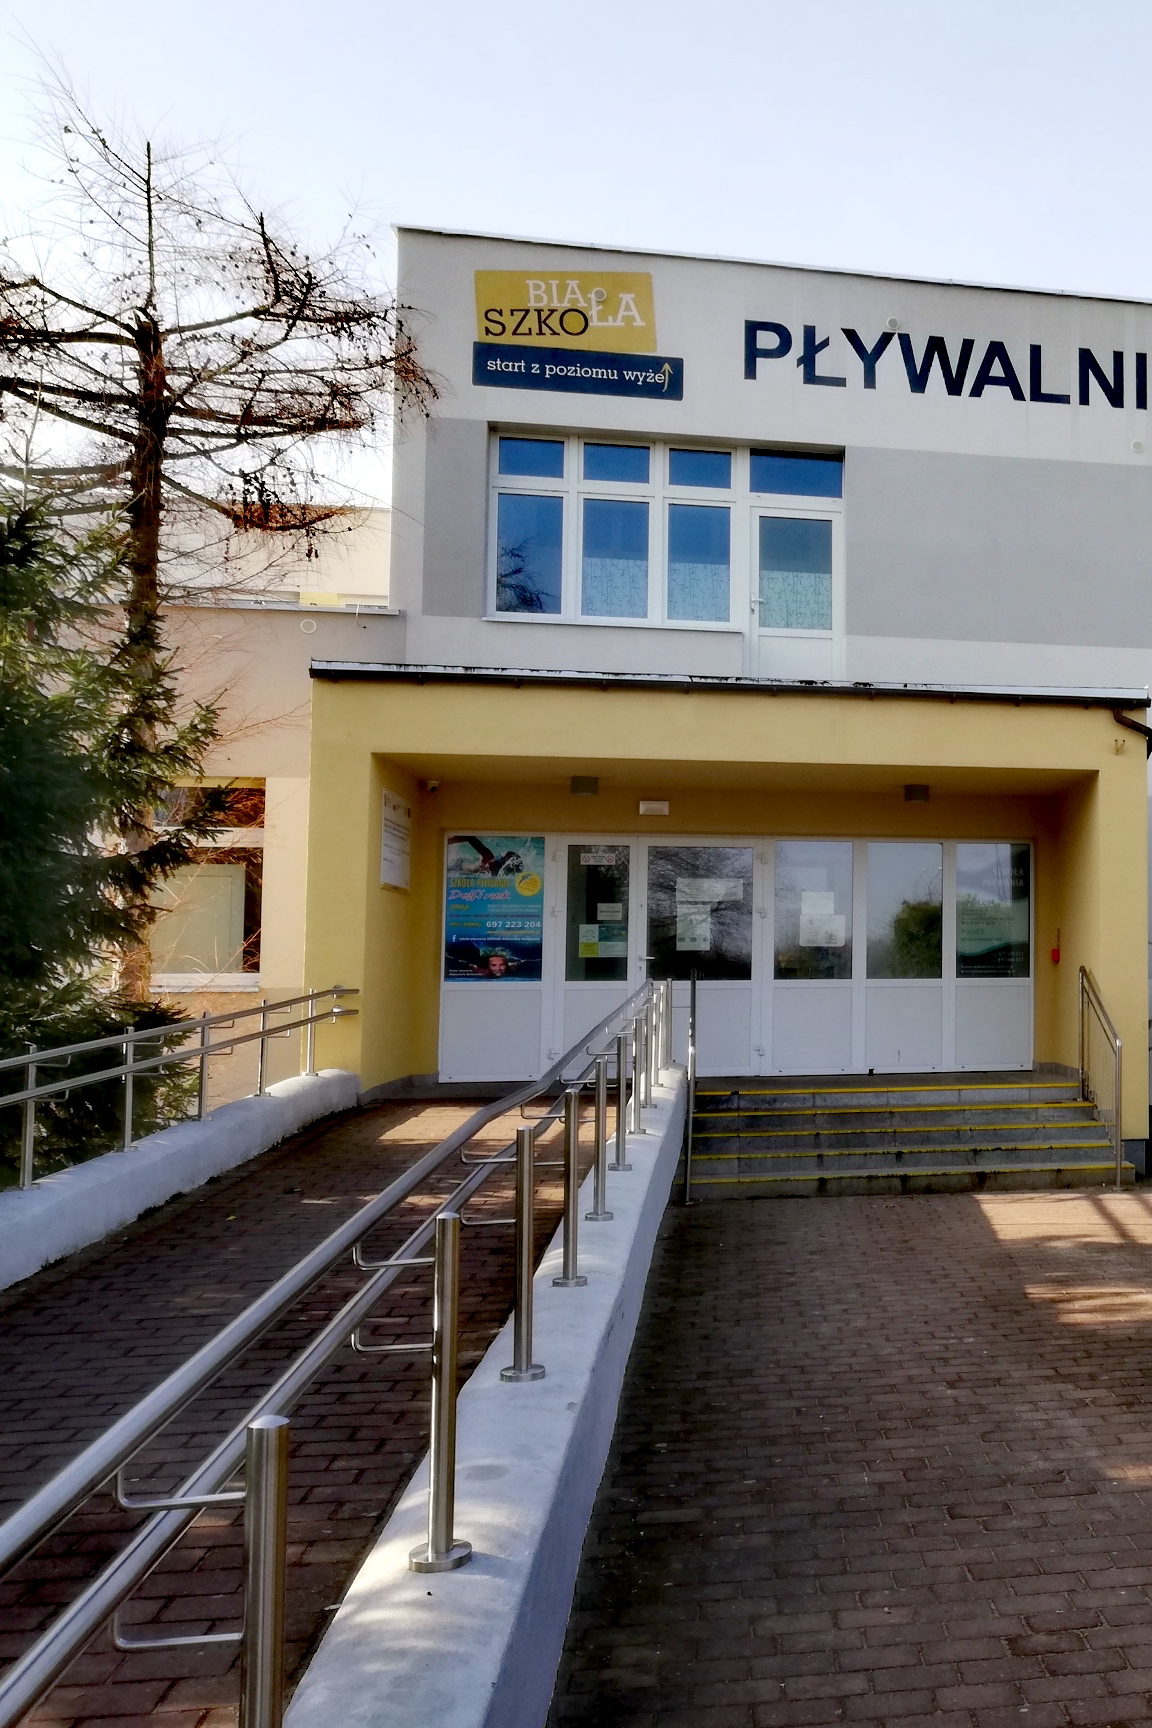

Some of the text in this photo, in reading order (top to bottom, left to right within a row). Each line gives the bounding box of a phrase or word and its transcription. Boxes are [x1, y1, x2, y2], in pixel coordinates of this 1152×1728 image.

[486, 358, 526, 374] start
[530, 363, 540, 374] z
[544, 362, 619, 380] poziomu
